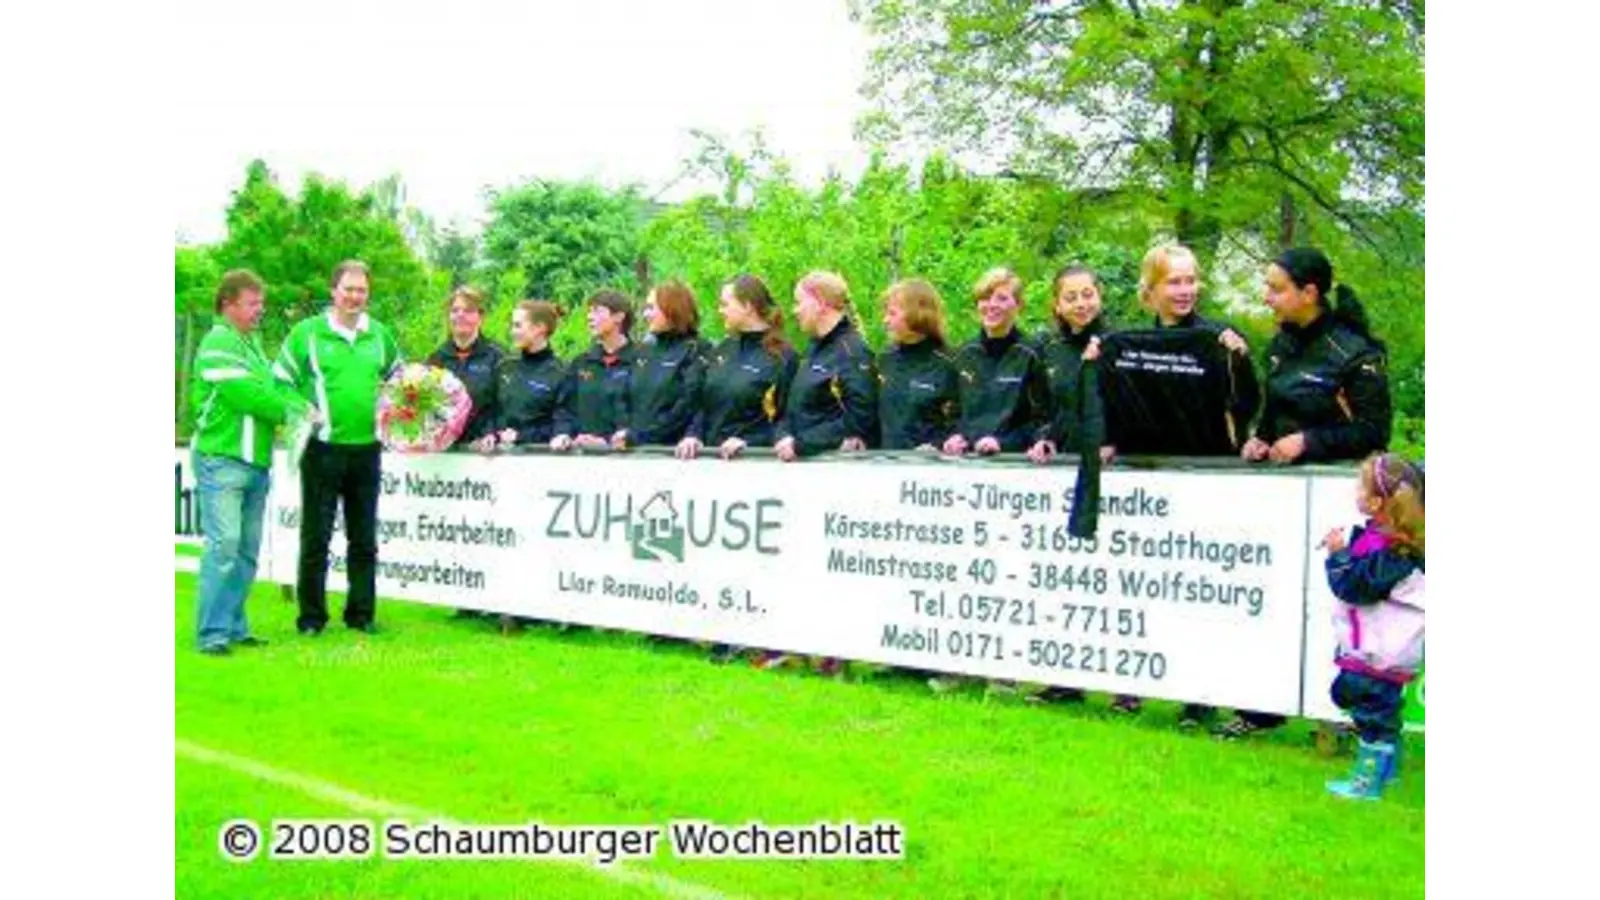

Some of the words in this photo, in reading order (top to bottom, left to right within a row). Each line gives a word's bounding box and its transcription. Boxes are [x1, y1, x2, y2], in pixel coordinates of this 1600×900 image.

[405, 471, 497, 507] Neubauten,
[900, 481, 1050, 519] Hans-Jürgen
[418, 514, 515, 548] Erdarbeiten
[973, 520, 989, 547] 5
[1108, 529, 1272, 573] Stadthagen
[827, 547, 957, 583] Meinstrasse
[967, 557, 997, 585] 40
[1028, 563, 1108, 594] 38448
[1118, 568, 1264, 617] Wolfsburg
[881, 625, 939, 654] Mobil
